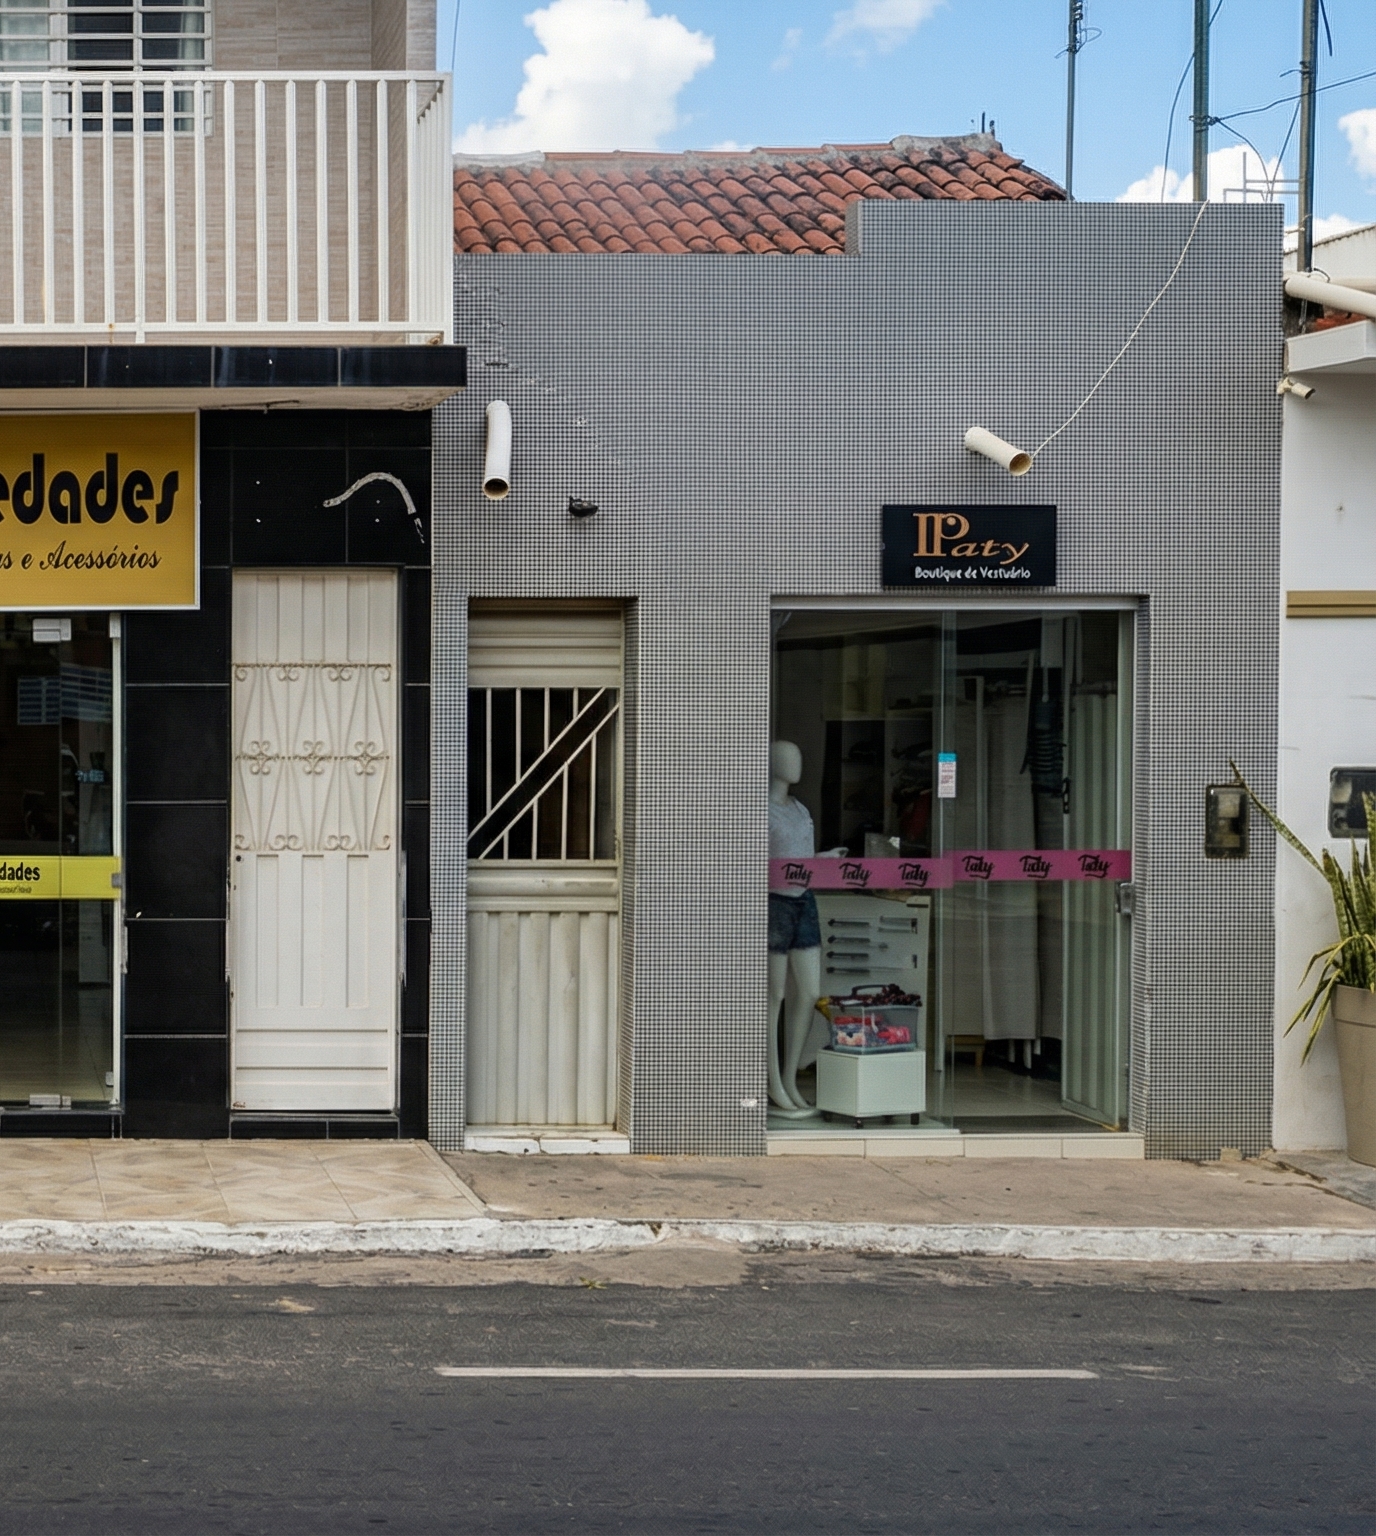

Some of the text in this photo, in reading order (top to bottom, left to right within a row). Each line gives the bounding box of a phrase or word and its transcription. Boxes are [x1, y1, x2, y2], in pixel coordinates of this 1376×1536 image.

[912, 512, 1029, 565] Paty
[21, 552, 34, 571] e
[39, 540, 161, 571] Acessórios
[914, 566, 962, 582] Boutique
[964, 567, 977, 579] de
